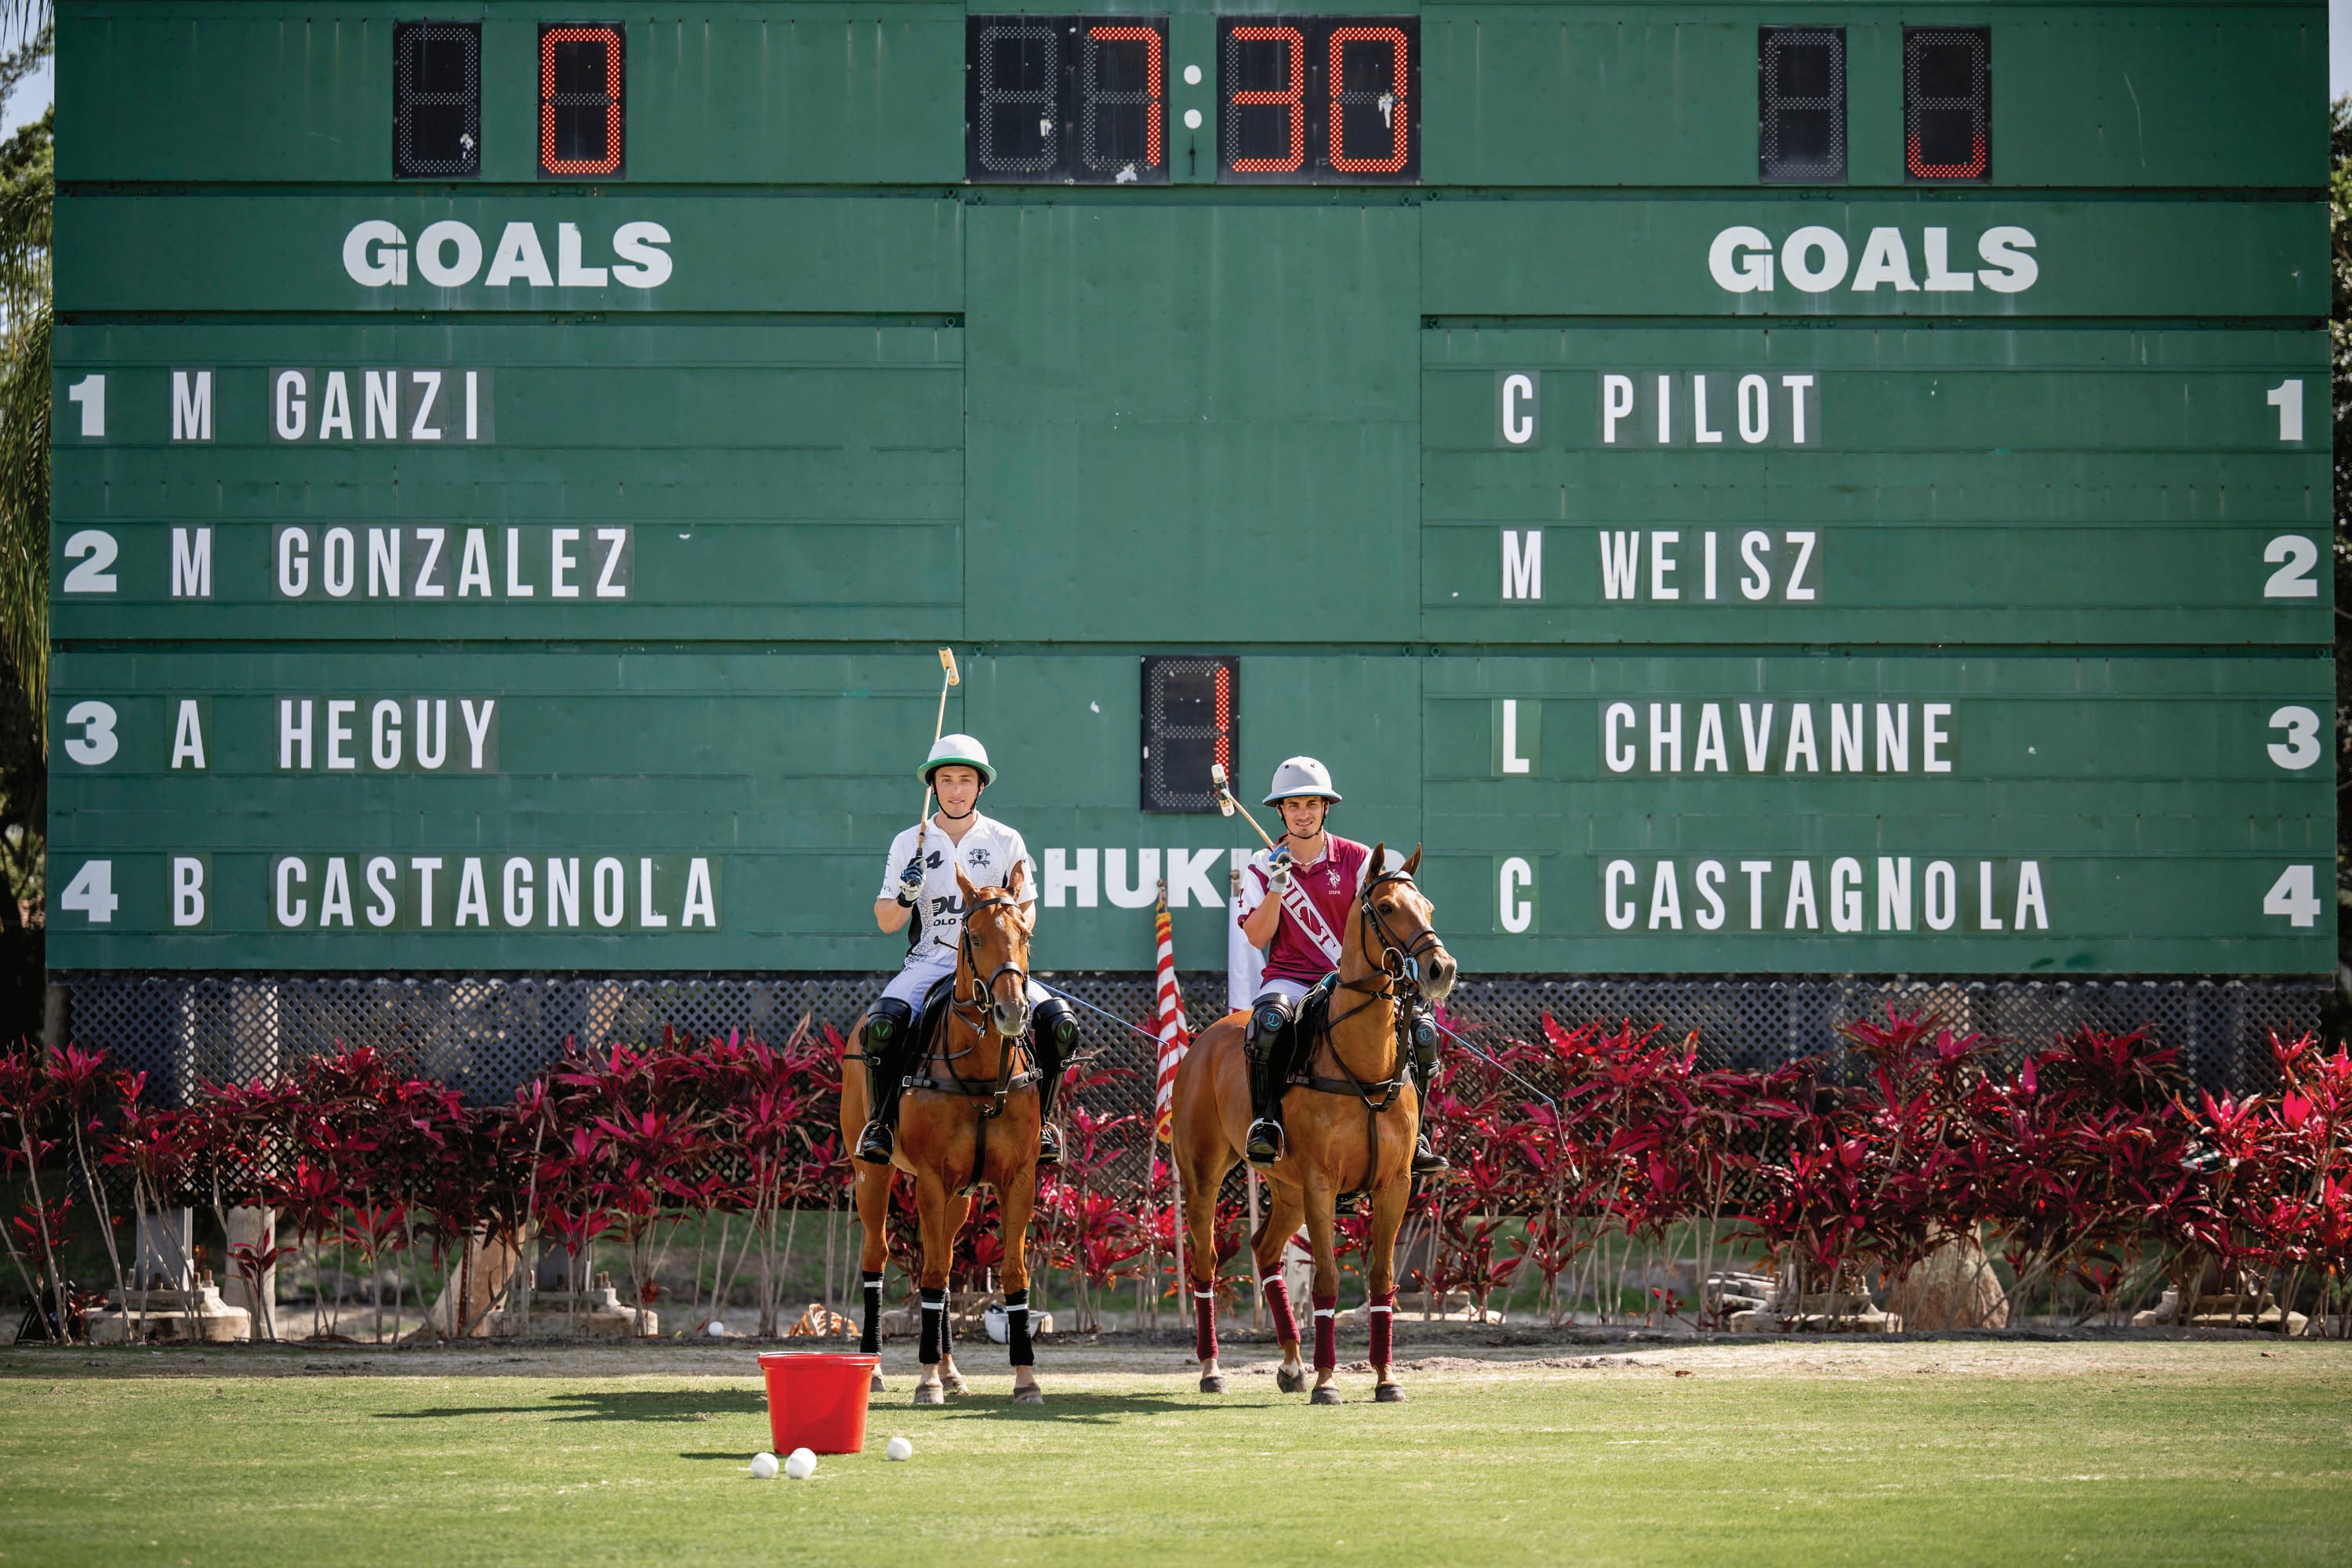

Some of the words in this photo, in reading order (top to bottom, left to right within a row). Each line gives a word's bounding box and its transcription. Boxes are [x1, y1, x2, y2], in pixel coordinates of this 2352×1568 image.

[543, 28, 619, 175] 0
[1090, 26, 1408, 173] 7:30
[343, 220, 673, 289] GOALS
[1708, 226, 2038, 294] GOALS
[70, 375, 105, 436] 1
[172, 371, 211, 440] M
[276, 370, 477, 441] GANZI
[1502, 374, 1534, 445] C
[1603, 374, 1813, 444] PILOT
[2267, 379, 2303, 441] 1
[64, 530, 118, 592] 2
[172, 528, 211, 597] M
[279, 527, 626, 597] GONZALEZ
[1502, 530, 1542, 600] M
[1599, 530, 1816, 601] WEISZ
[2263, 535, 2318, 597] 2
[65, 701, 118, 766] 3
[172, 700, 205, 769] A
[281, 699, 495, 770] HEGUY
[1215, 667, 1229, 797] 1
[1502, 699, 1530, 774] L
[1605, 702, 1951, 773] CHAVANNE
[2267, 706, 2321, 770] 3
[61, 860, 118, 922] 4
[174, 857, 205, 926] B
[277, 856, 717, 927] CASTAGNOLA
[1501, 856, 1532, 934] C
[1605, 856, 2049, 933] CASTAGNOLA
[2263, 865, 2321, 927] 4
